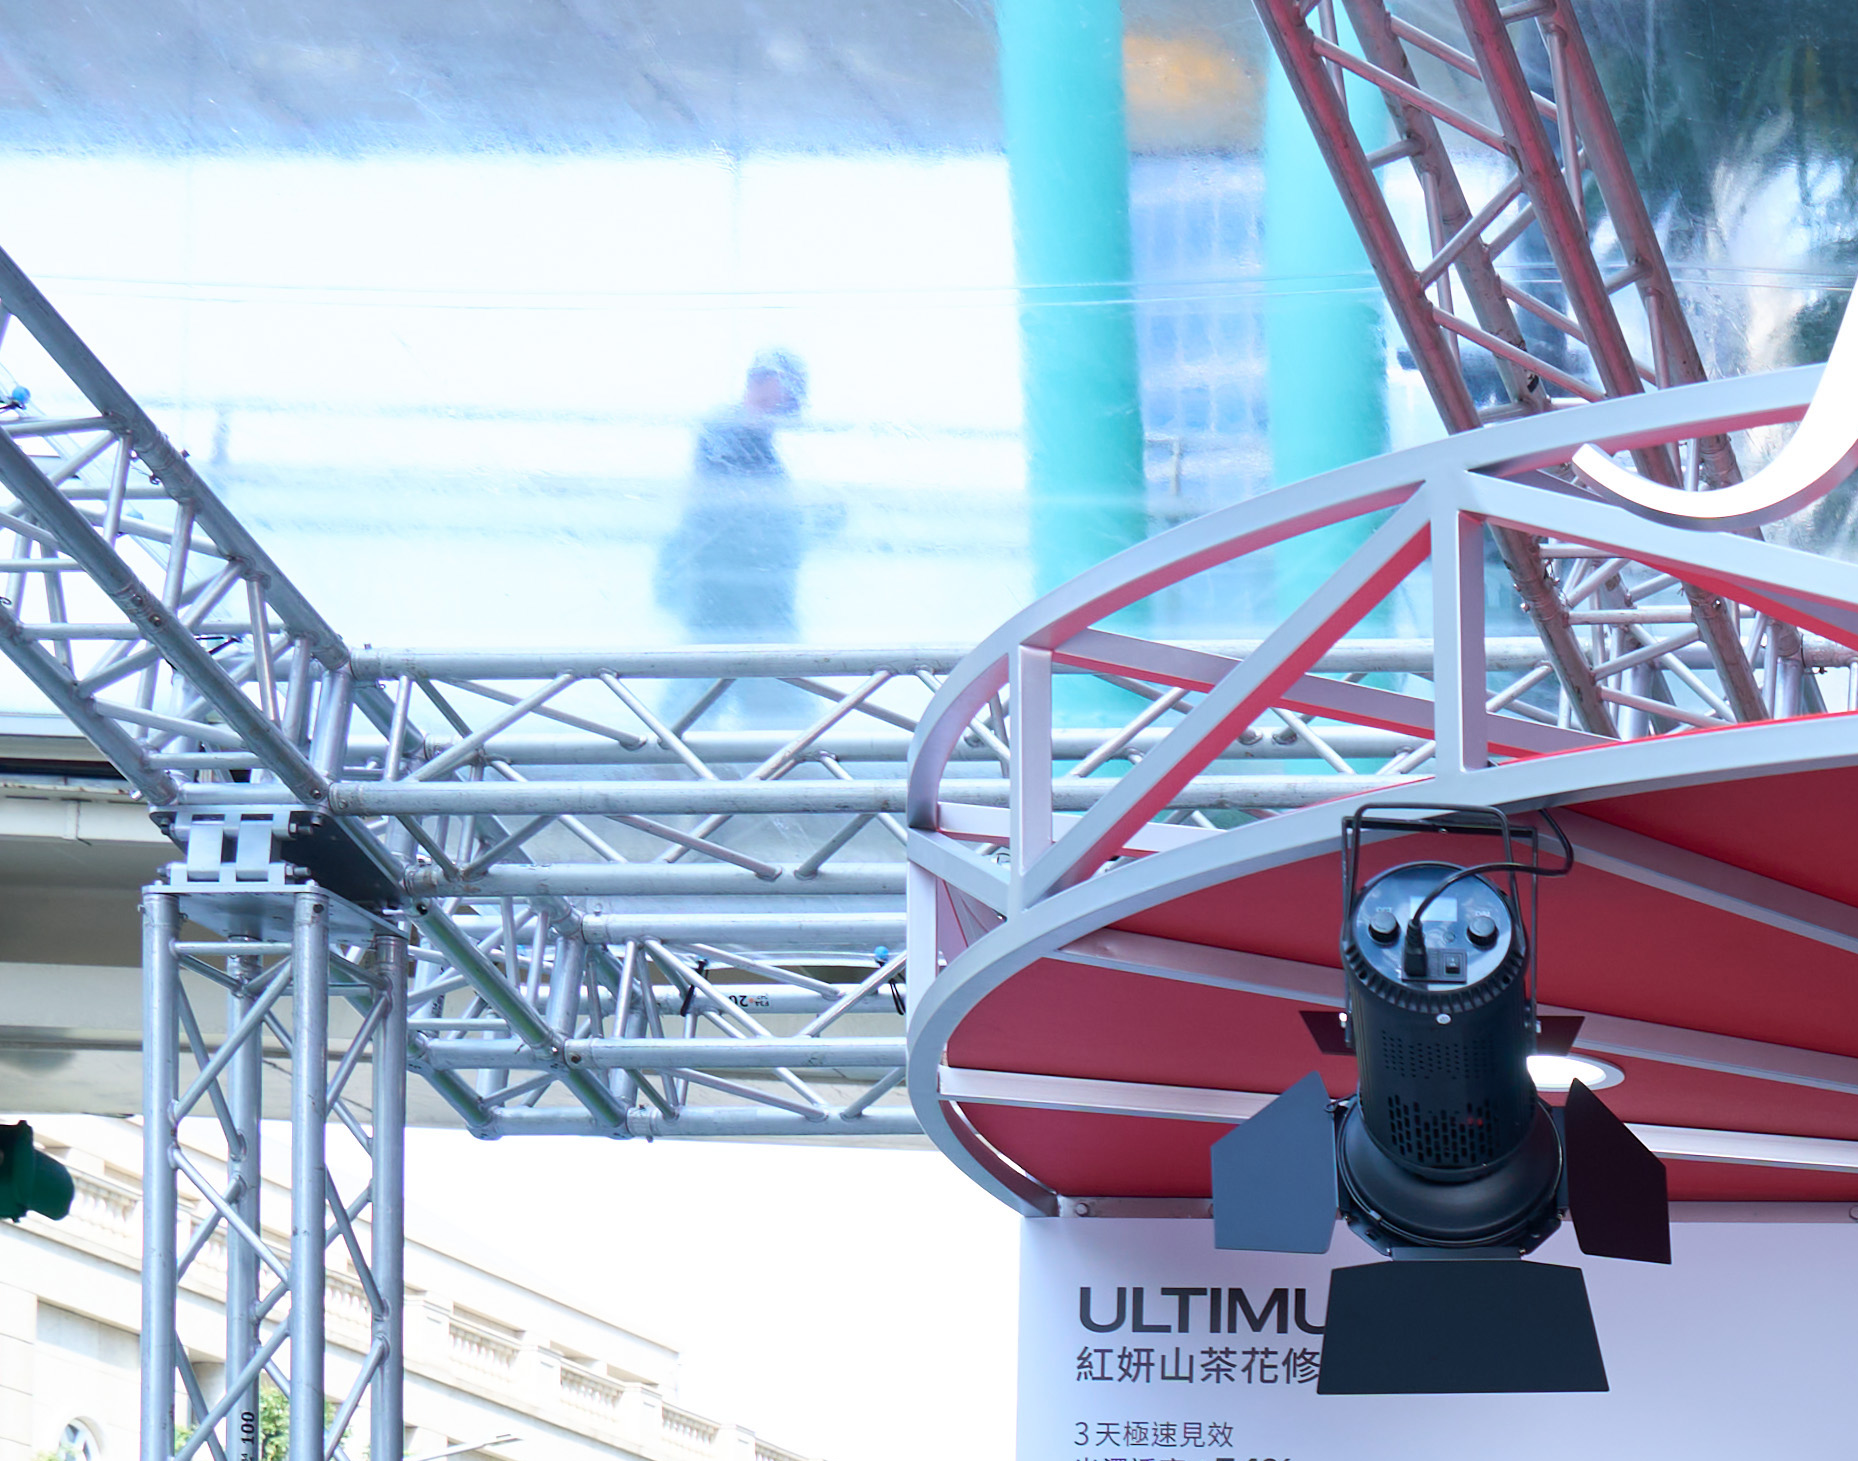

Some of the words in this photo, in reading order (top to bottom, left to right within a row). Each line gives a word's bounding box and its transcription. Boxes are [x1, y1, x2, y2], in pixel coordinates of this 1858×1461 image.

[1079, 1286, 1328, 1335] ULTIMU
[1075, 1346, 1320, 1385] 紅妍山茶花修
